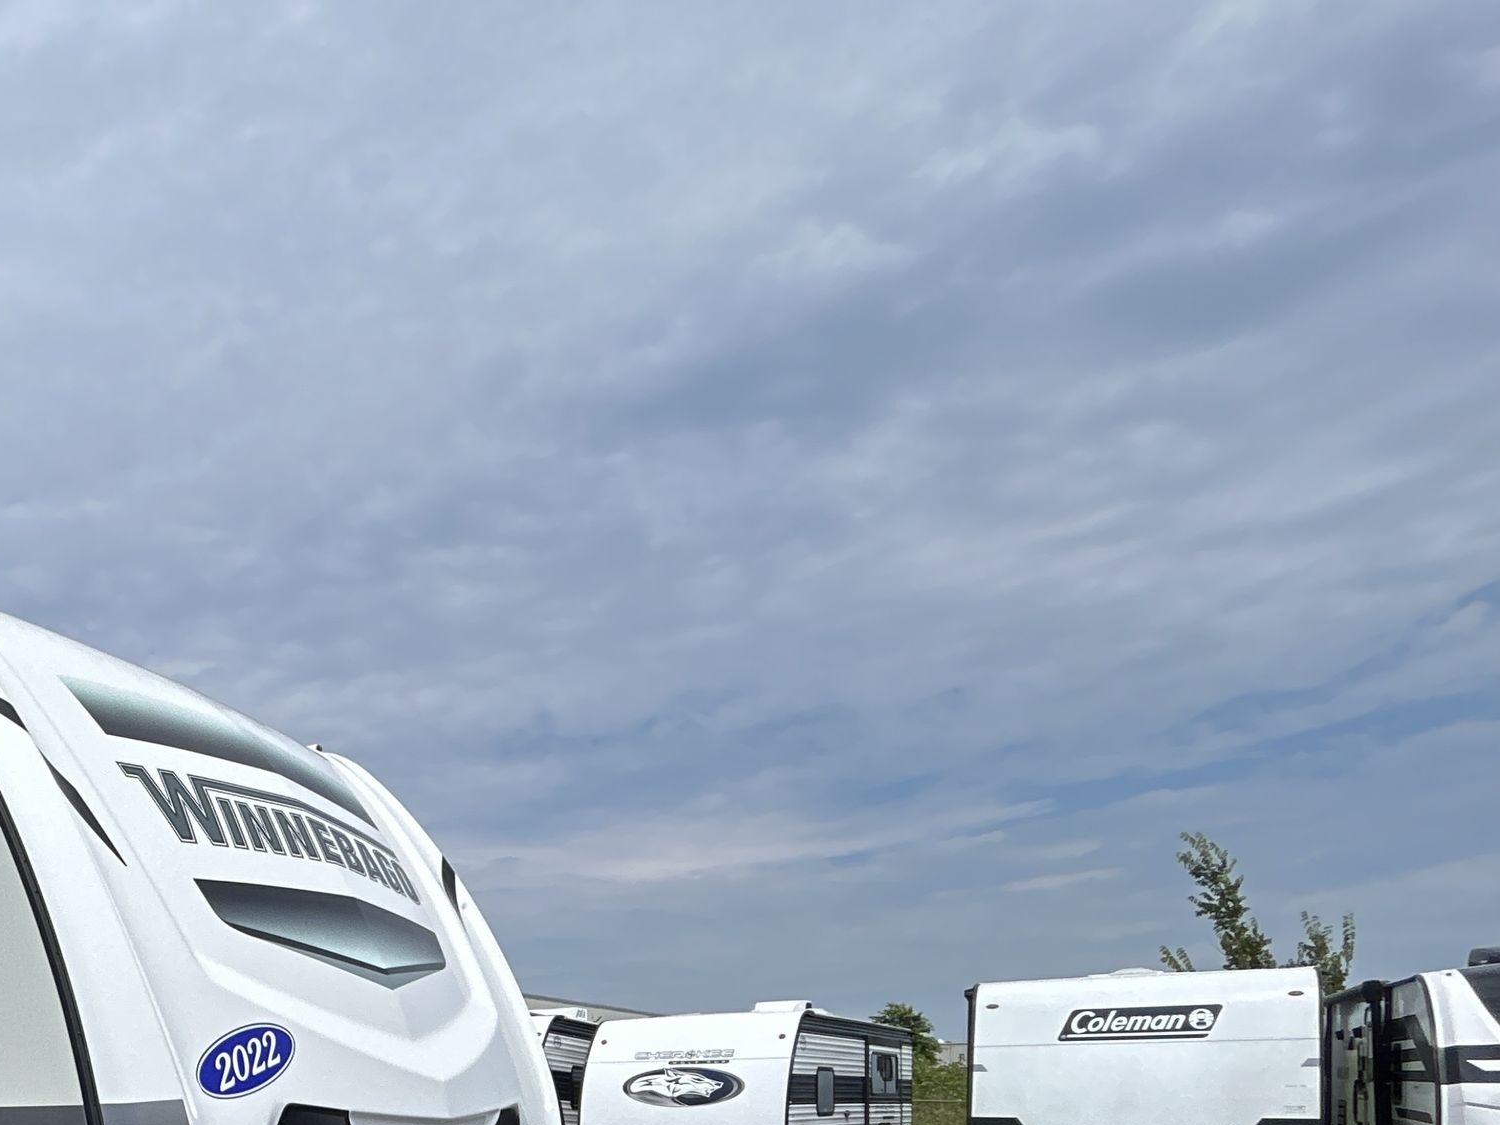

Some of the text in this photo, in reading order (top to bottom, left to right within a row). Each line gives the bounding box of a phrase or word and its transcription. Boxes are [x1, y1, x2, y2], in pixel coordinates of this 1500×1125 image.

[115, 761, 421, 906] WINNEBAGO
[1070, 1010, 1186, 1034] Coleman
[215, 1030, 281, 1092] 2022
